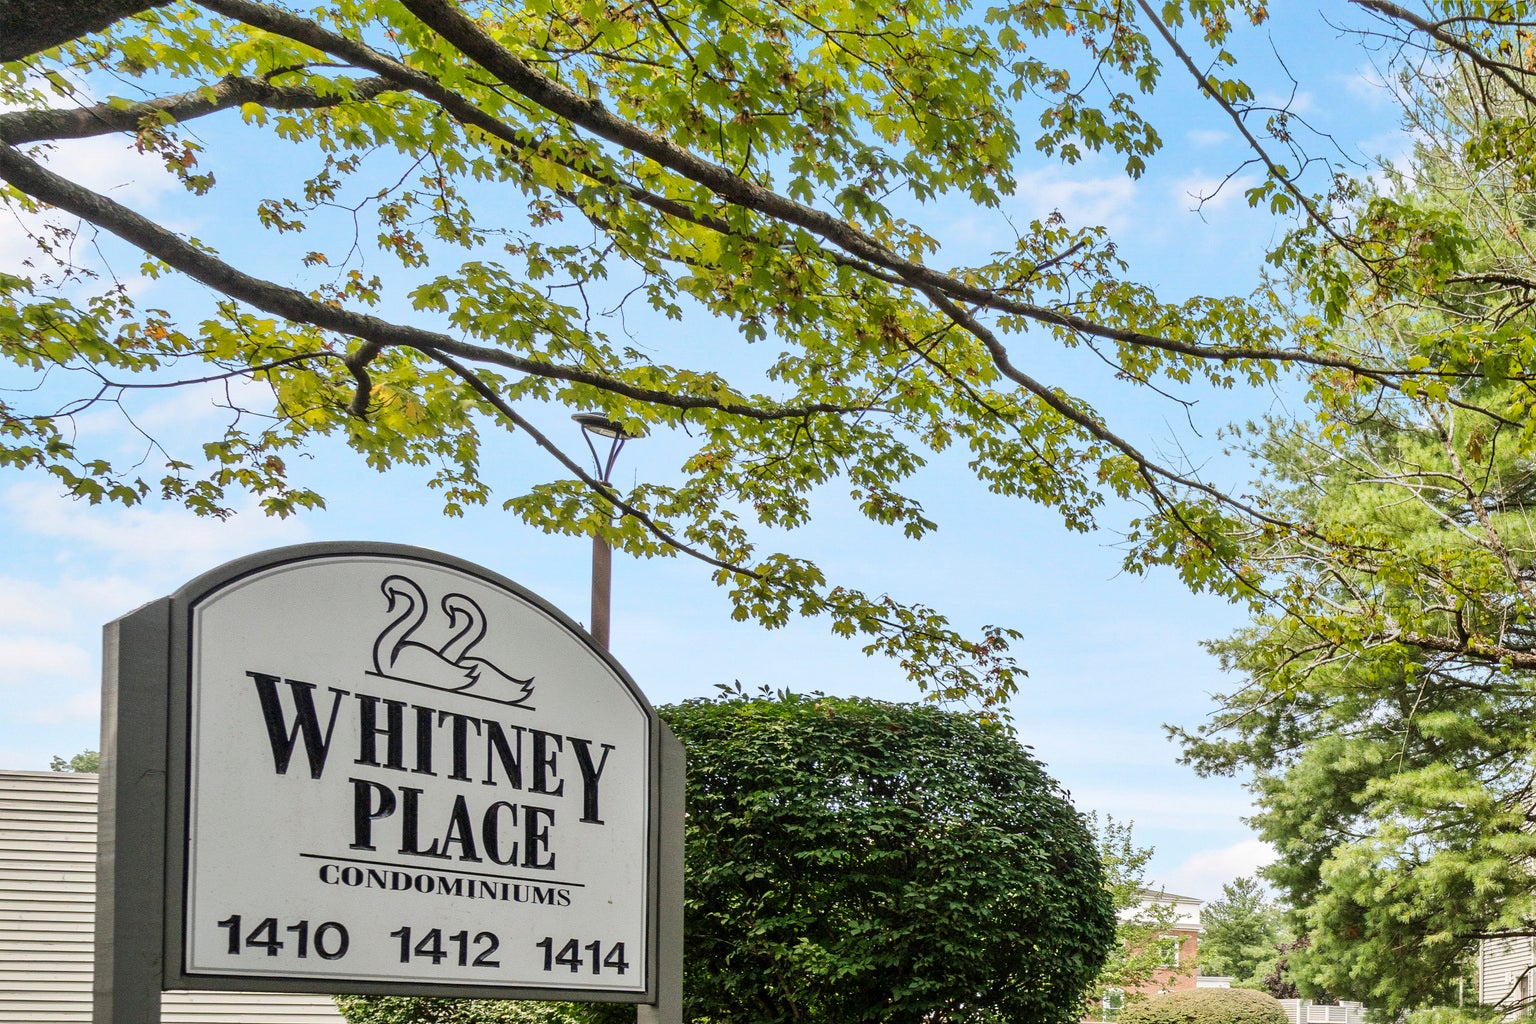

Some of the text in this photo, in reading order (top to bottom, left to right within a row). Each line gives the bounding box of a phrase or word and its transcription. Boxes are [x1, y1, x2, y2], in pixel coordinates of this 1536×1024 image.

[245, 670, 616, 826] WHITNEY
[348, 776, 557, 872] PLACE
[318, 864, 572, 908] CONDOMINIUMS
[217, 914, 630, 976] 1410 1412 1414
